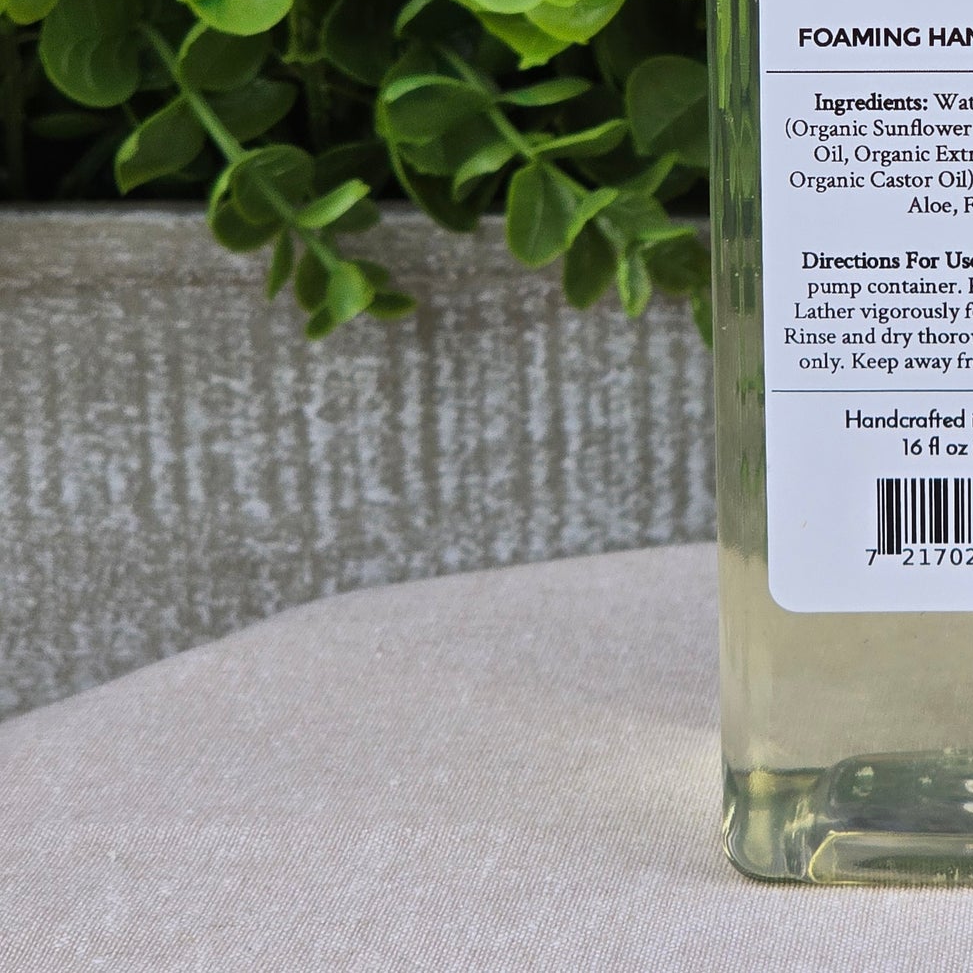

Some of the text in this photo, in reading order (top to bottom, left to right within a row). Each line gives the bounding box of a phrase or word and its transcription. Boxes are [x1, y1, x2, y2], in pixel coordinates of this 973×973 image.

[798, 26, 921, 48] FOAMING
[814, 91, 929, 115] Ingredients:
[785, 117, 868, 141] (Organic
[872, 117, 973, 137] Sunflower
[813, 144, 849, 166] Oil,
[854, 144, 931, 166] Organic
[789, 170, 865, 192] Organic
[870, 170, 934, 189] Castor
[906, 195, 958, 217] Aloe,
[801, 251, 901, 270] Directions
[905, 250, 941, 270] For
[807, 282, 862, 299] pump
[867, 277, 962, 295] container.
[793, 301, 856, 320] Lather
[859, 301, 961, 324] vigorously
[783, 327, 837, 345] Rinse
[841, 326, 877, 345] and
[881, 326, 914, 349] dry
[798, 351, 845, 375] only.
[851, 352, 899, 375] Keep
[904, 356, 953, 375] away
[845, 407, 966, 429] Handcrafted
[902, 437, 923, 456] 16
[928, 435, 940, 456] fl
[945, 443, 969, 456] oz
